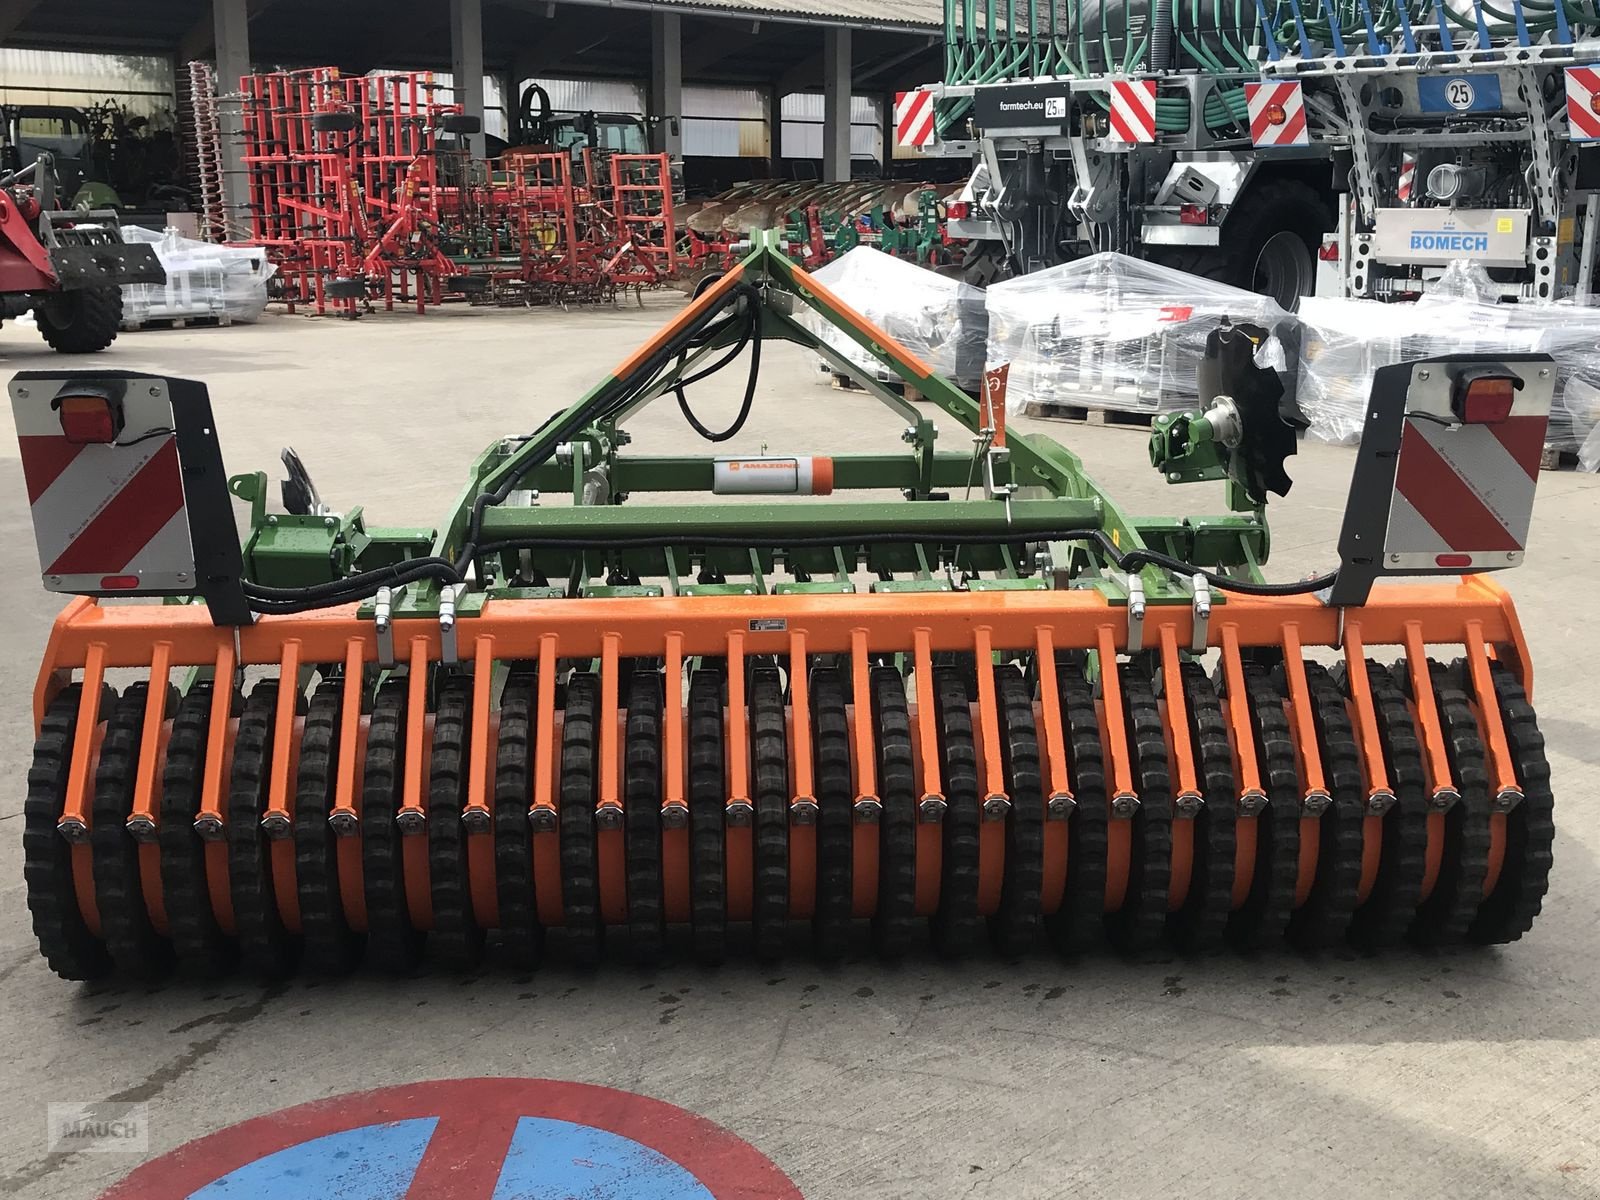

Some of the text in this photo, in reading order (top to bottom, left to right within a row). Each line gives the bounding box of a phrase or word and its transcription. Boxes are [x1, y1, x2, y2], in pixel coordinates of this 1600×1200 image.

[1451, 85, 1469, 103] 25
[999, 100, 1044, 111] farmtech.eu
[1047, 100, 1058, 116] 25
[1410, 236, 1488, 251] BOMECH
